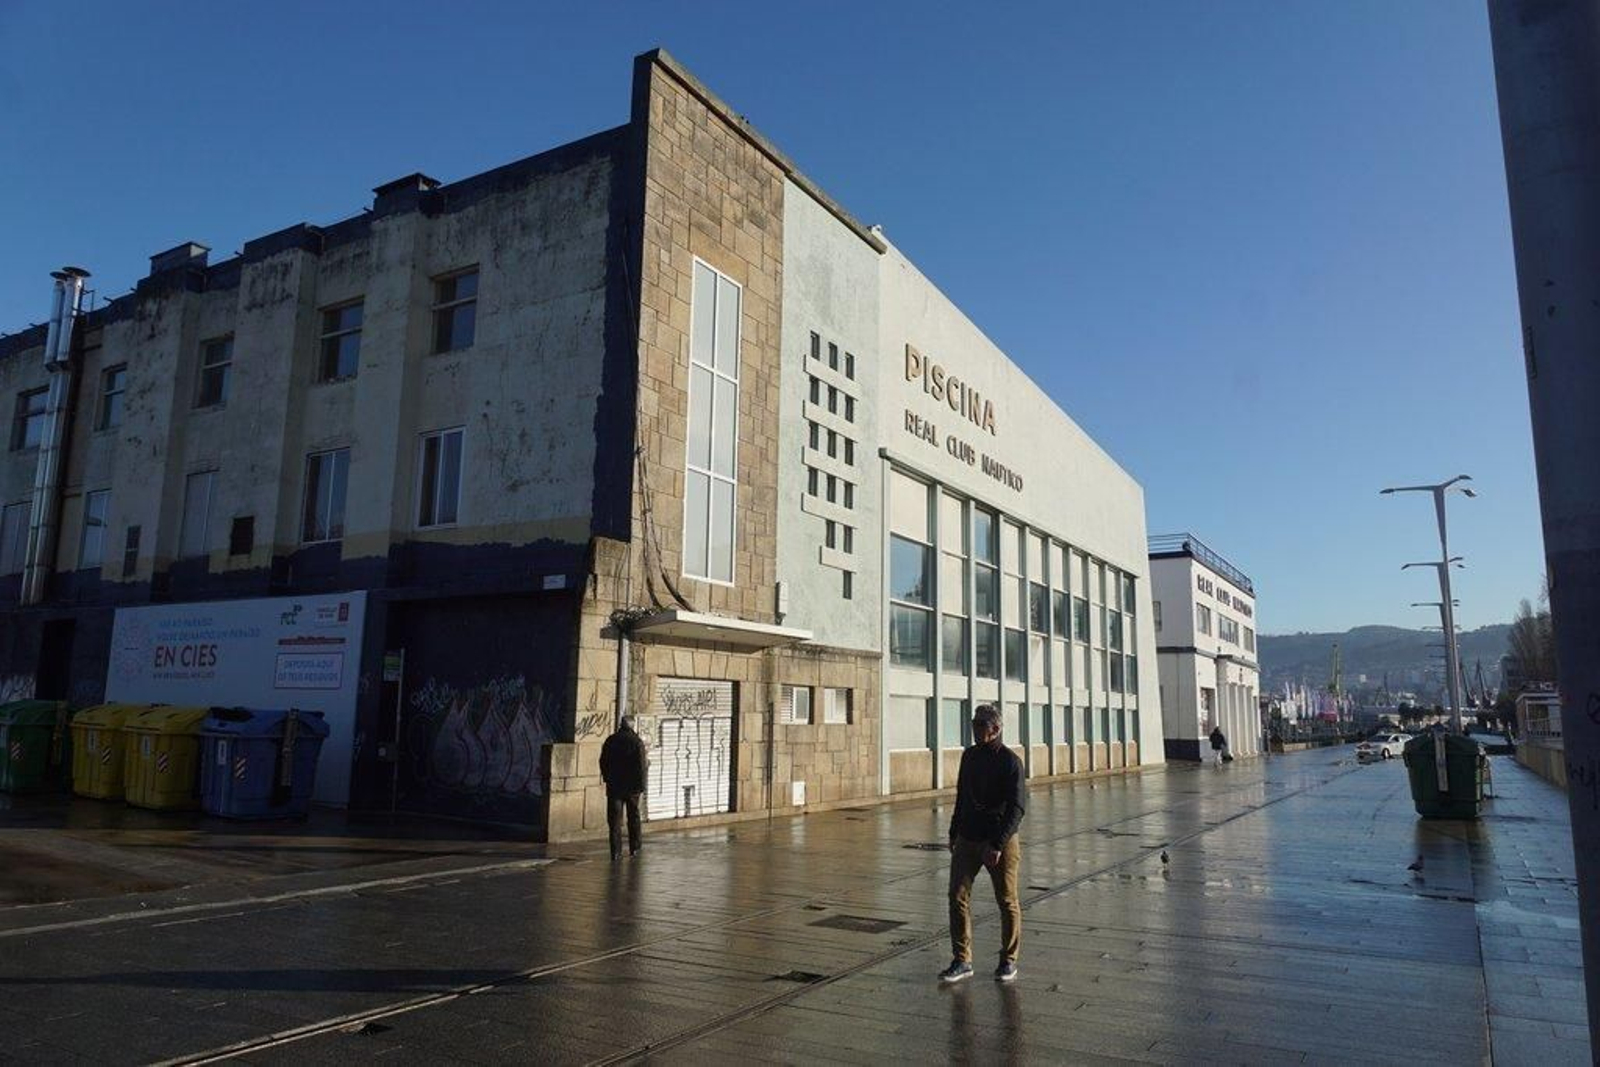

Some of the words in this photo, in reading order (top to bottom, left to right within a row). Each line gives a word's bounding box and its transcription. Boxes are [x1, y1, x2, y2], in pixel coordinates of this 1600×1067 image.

[905, 343, 996, 436] PISCINA
[905, 409, 939, 448] REAL
[947, 435, 975, 466] CLUB
[154, 645, 176, 668] EN
[181, 644, 218, 668] CIES
